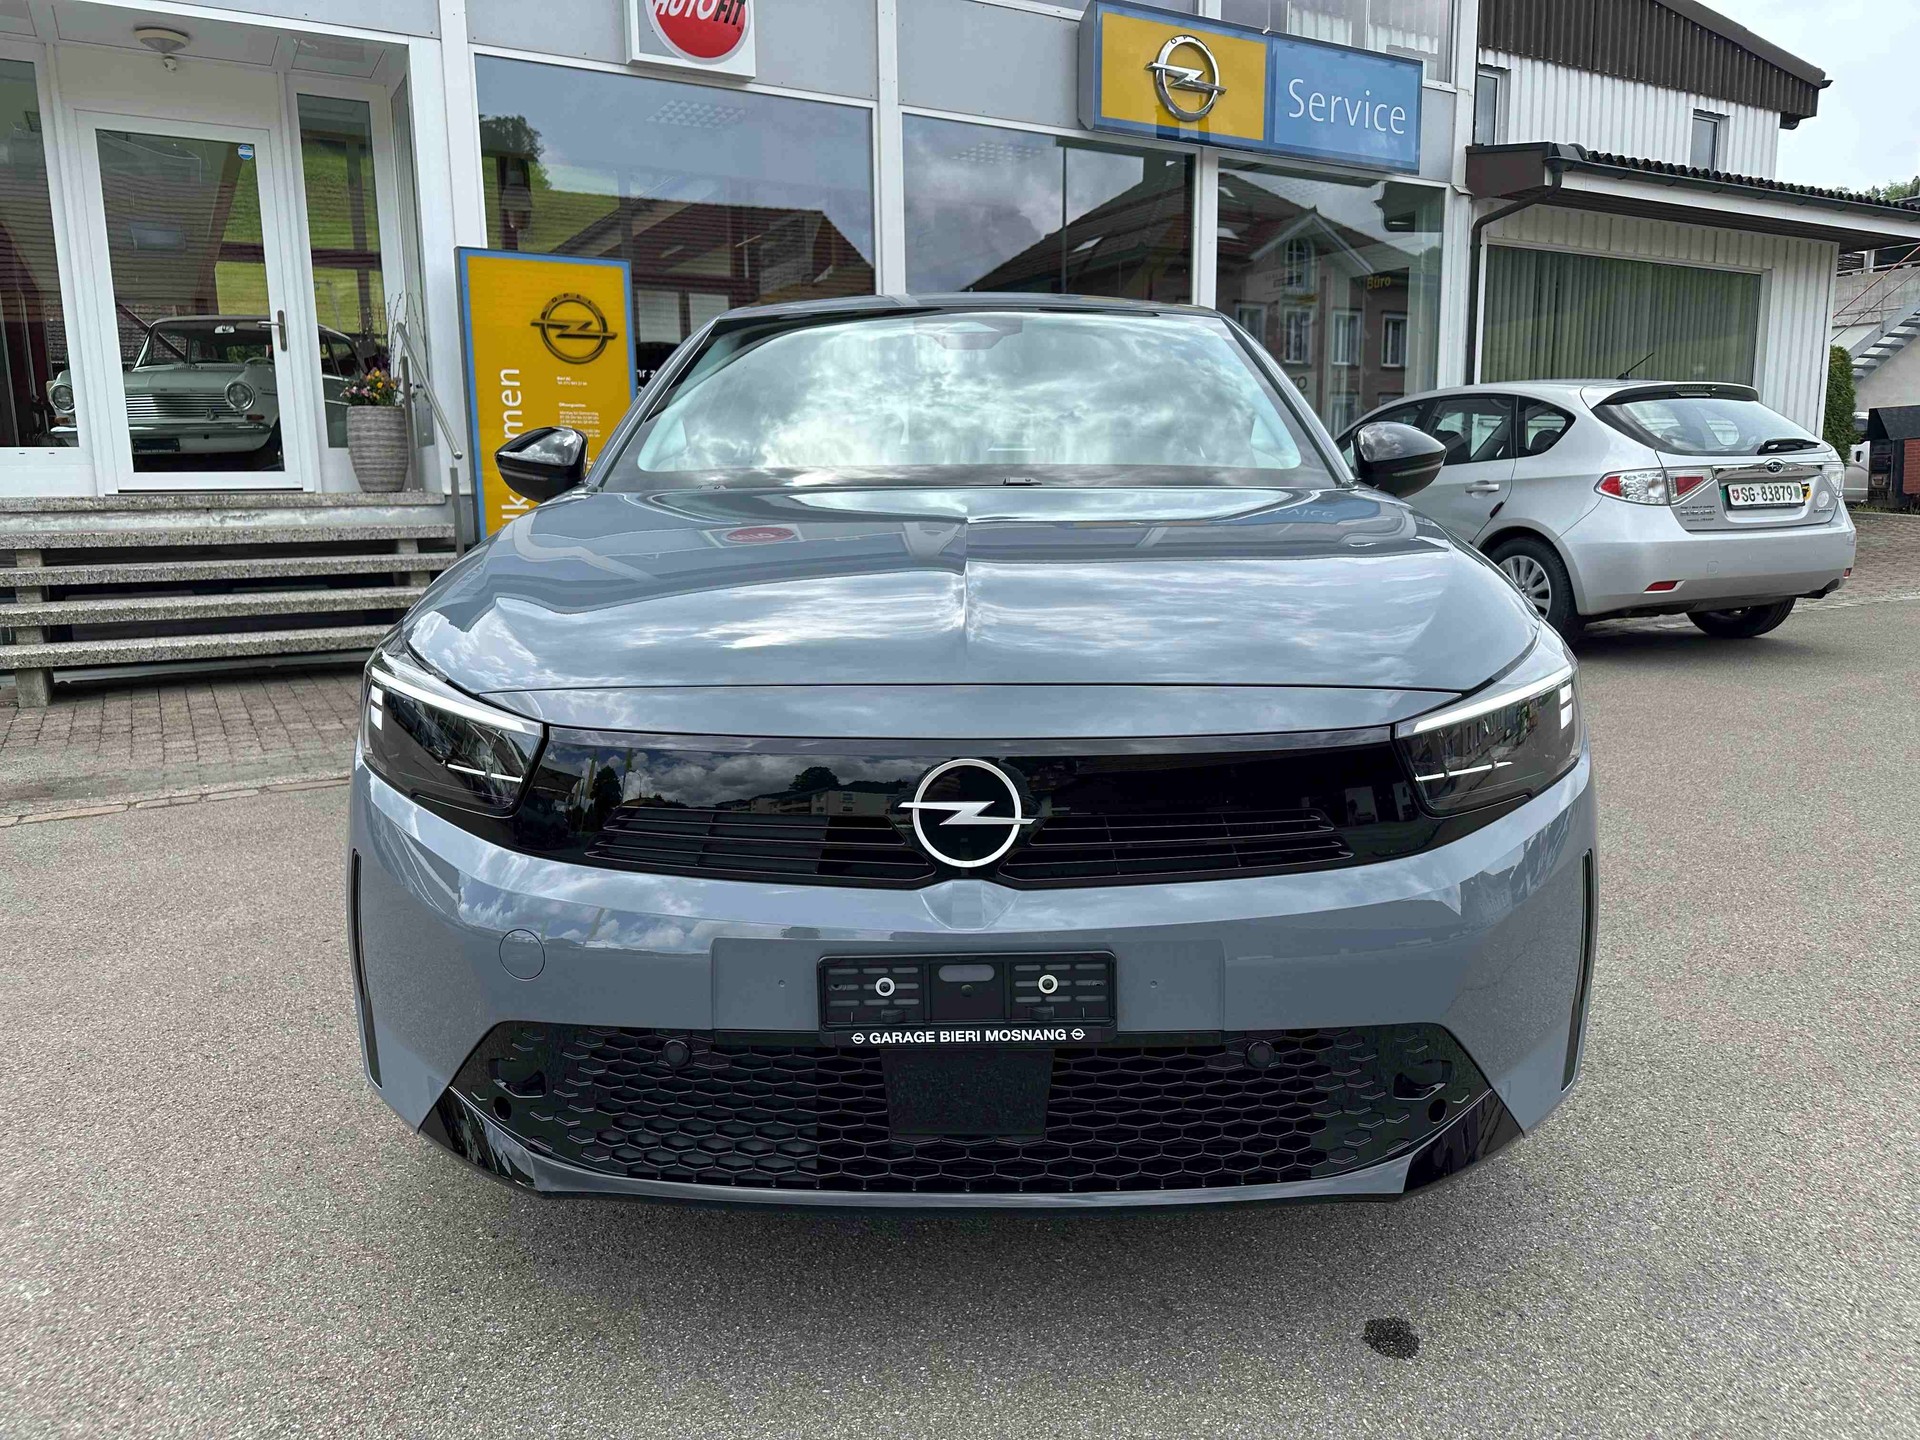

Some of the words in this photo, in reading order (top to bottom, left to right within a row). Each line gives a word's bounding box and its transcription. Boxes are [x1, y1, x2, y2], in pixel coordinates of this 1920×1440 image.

[1288, 78, 1406, 134] Service
[1366, 274, 1391, 290] Büro
[869, 1031, 936, 1044] GARAGE
[939, 1029, 981, 1043] BIERI
[985, 1028, 1067, 1042] MOSNANG
